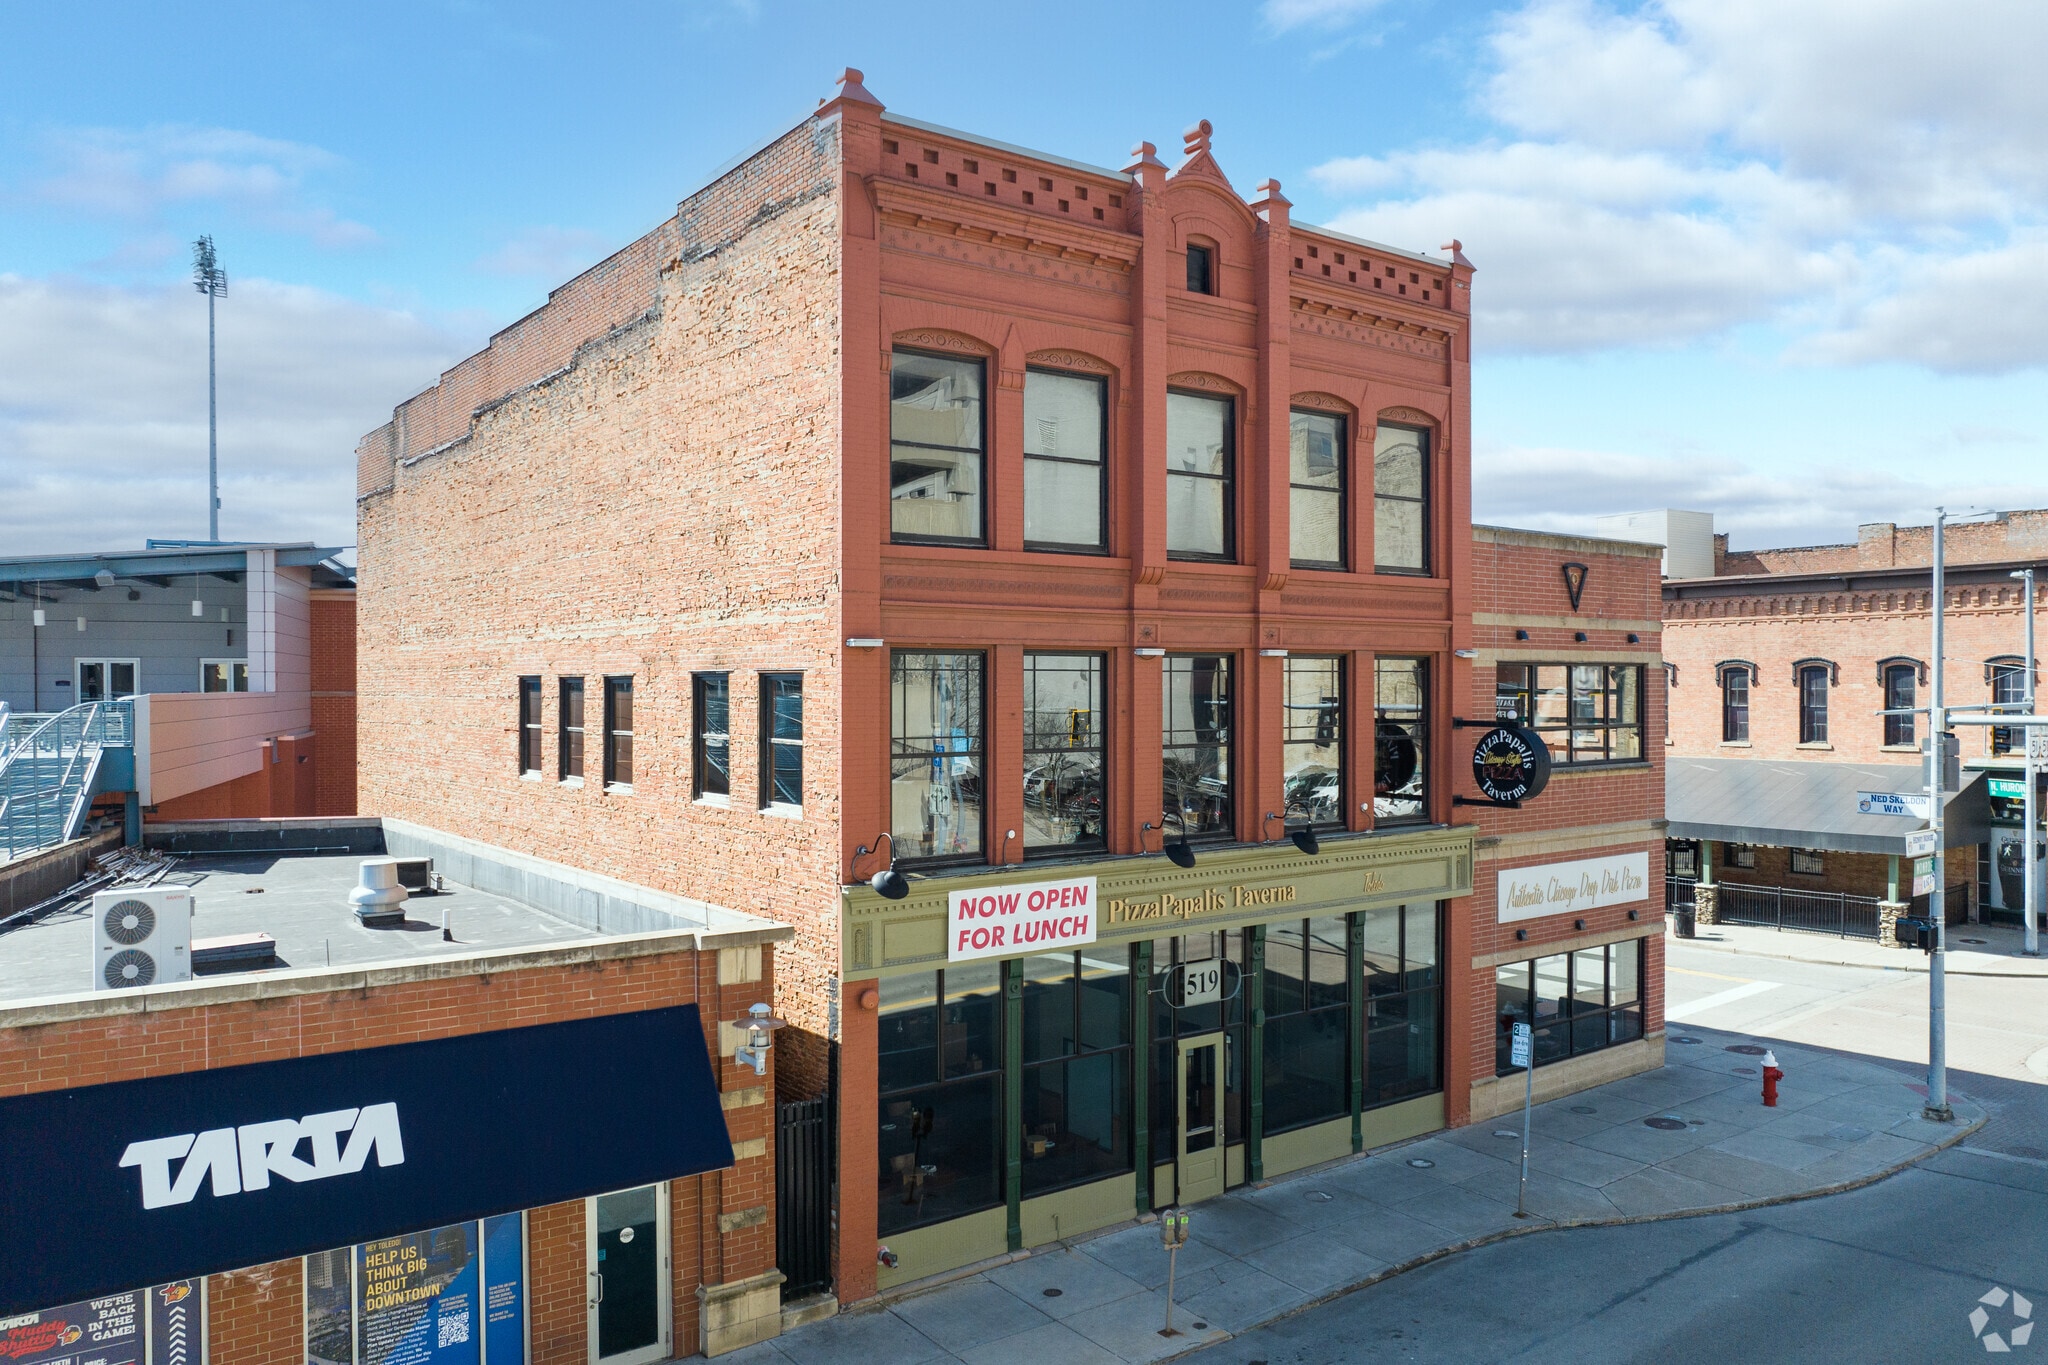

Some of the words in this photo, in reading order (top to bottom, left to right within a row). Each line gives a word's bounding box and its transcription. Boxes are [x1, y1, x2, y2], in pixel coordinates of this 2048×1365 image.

[1474, 730, 1534, 769] PizzaPapalis
[1482, 778, 1527, 801] Taverna
[2000, 781, 2026, 793] HURON
[1870, 795, 1888, 803] NED
[1889, 795, 1927, 805] SKELDON
[1883, 804, 1904, 813] WAY
[1363, 871, 1385, 892] Toledo
[1506, 881, 1544, 910] Authentic
[1546, 876, 1578, 908] Chicago
[1579, 871, 1599, 905] Deep
[1601, 868, 1619, 894] Dish
[1621, 865, 1642, 891] Pizza
[958, 892, 1021, 921] NOW
[1027, 885, 1089, 912] OPEN
[1107, 887, 1226, 924] PizzaPapalis
[1231, 885, 1297, 908] Taverna
[957, 925, 1006, 952] FOR
[1013, 915, 1089, 945] LUNCH
[1186, 969, 1219, 996] 519
[118, 1101, 405, 1210] TARTA
[365, 1242, 377, 1252] HEY
[365, 1250, 398, 1268] HELP
[401, 1246, 417, 1260] US
[366, 1262, 404, 1282] THINK
[407, 1258, 428, 1274] BIG
[366, 1276, 408, 1297] ABOUT
[366, 1283, 440, 1312] DOWNTOWN
[90, 1294, 133, 1310] WE'RE
[99, 1304, 136, 1319] BACK
[8, 1320, 67, 1340] Muddy
[88, 1322, 103, 1333] IN
[105, 1315, 134, 1328] THE
[92, 1325, 136, 1341] GAME!
[0, 1334, 58, 1356] Shuttle
